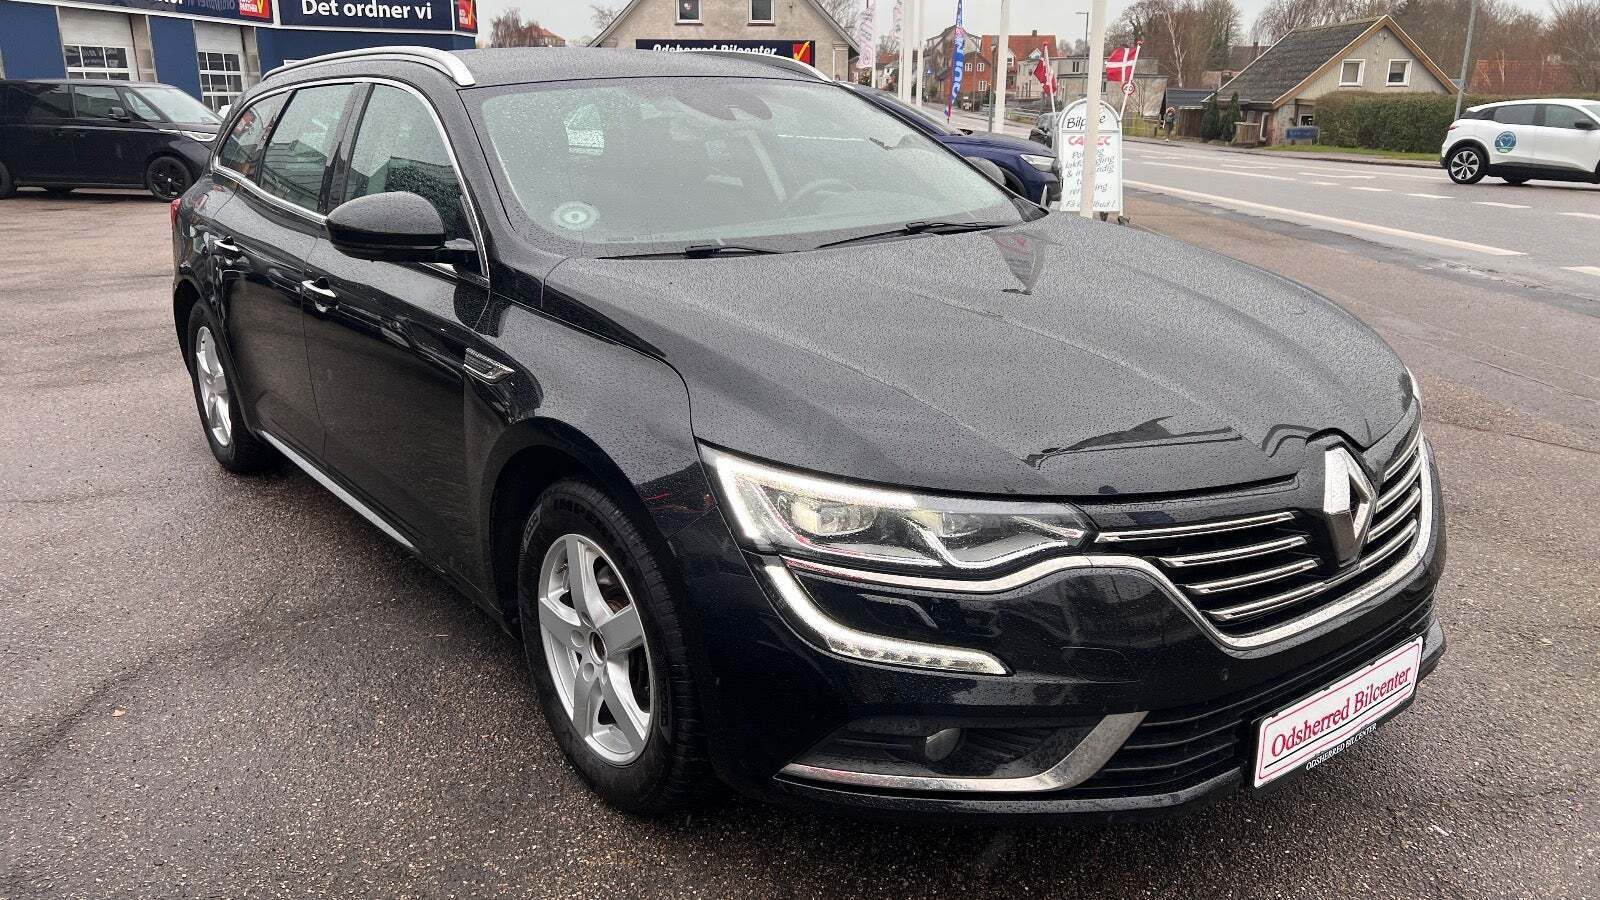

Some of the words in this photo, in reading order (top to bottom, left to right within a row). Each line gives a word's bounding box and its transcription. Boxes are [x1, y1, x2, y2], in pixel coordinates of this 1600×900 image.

[302, 0, 339, 16] Det
[344, 0, 411, 19] ordner
[414, 2, 432, 20] vi
[1067, 115, 1106, 131] Bilpe
[1068, 136, 1111, 145] CAEC
[1271, 697, 1350, 757] Odsherred
[1352, 667, 1411, 714] Bilcenter
[1306, 744, 1345, 771] ODSHERRED
[1345, 723, 1377, 749] BILCENTER
